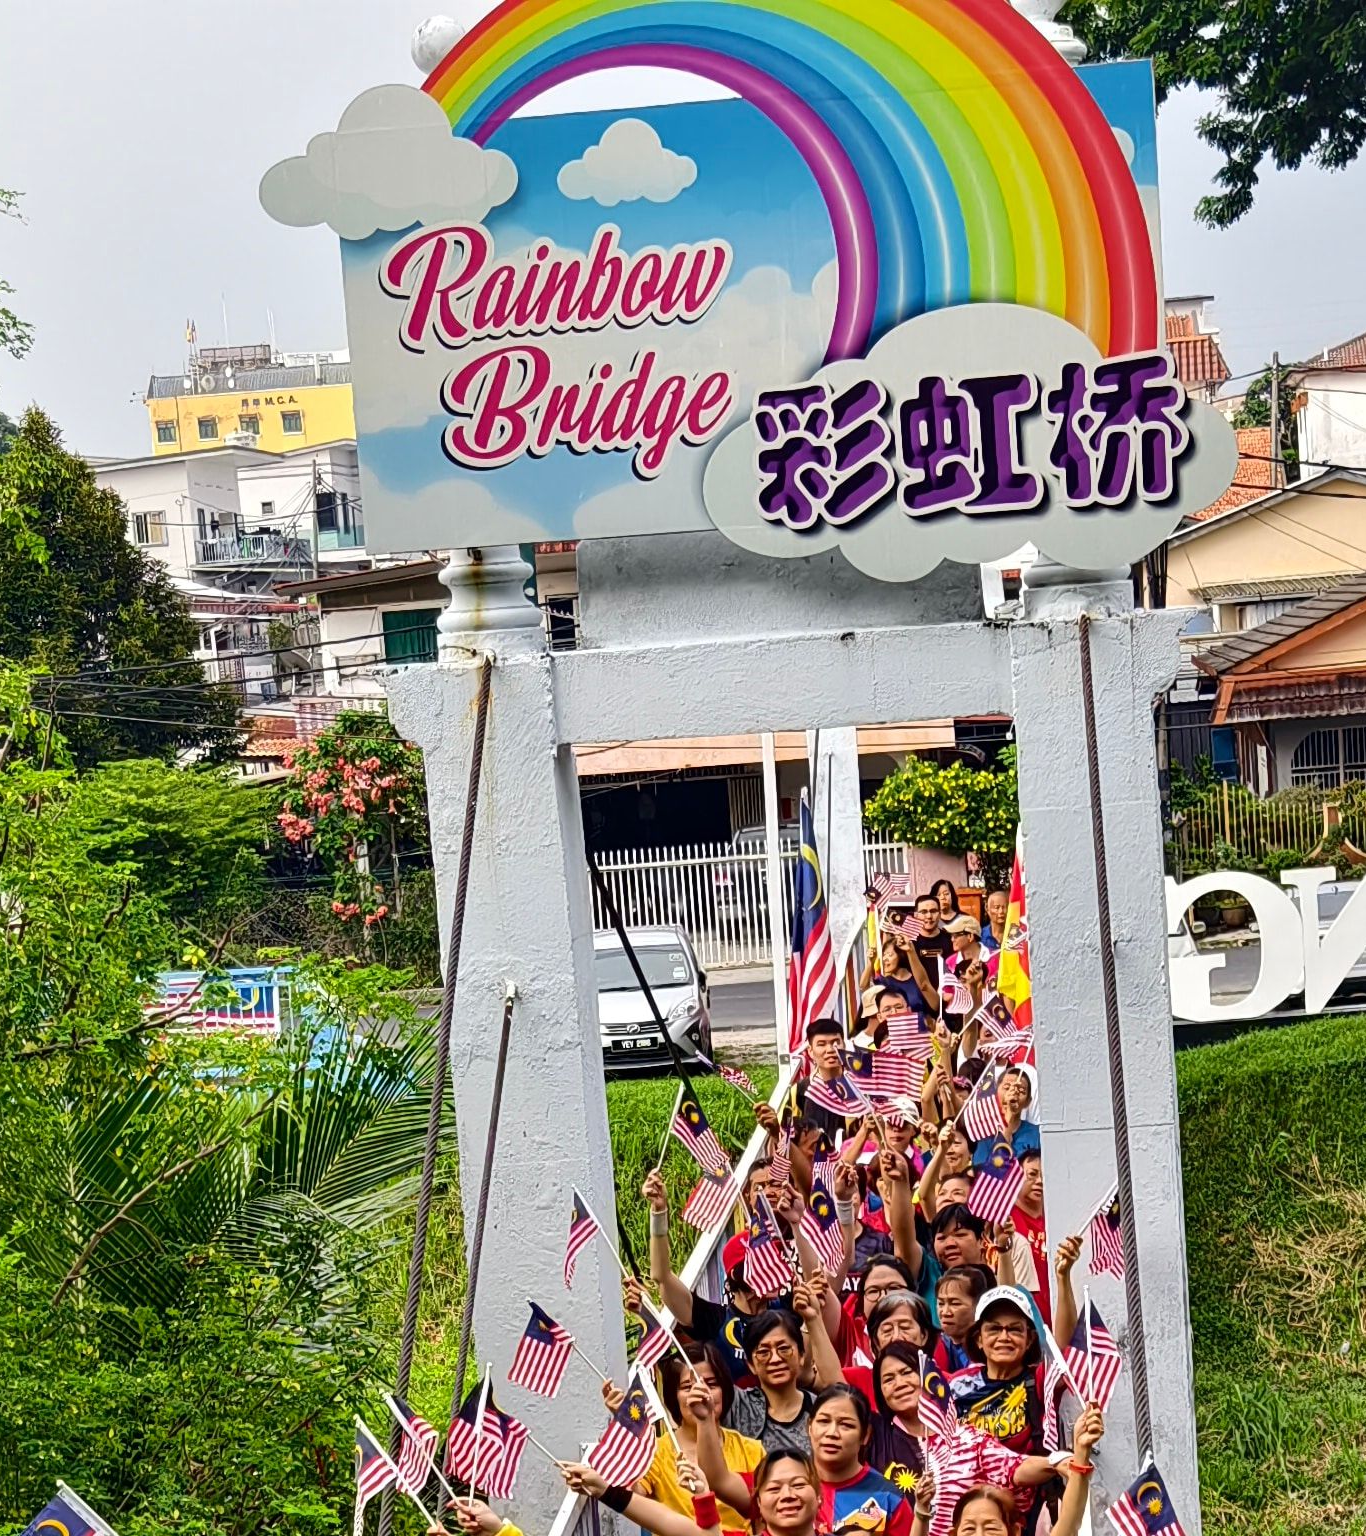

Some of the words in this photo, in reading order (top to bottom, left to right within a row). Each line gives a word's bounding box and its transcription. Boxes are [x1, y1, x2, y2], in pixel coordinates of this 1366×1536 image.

[384, 223, 730, 345] Rainbow
[445, 345, 734, 473] Bridge
[752, 353, 1188, 527] 彩虹桥
